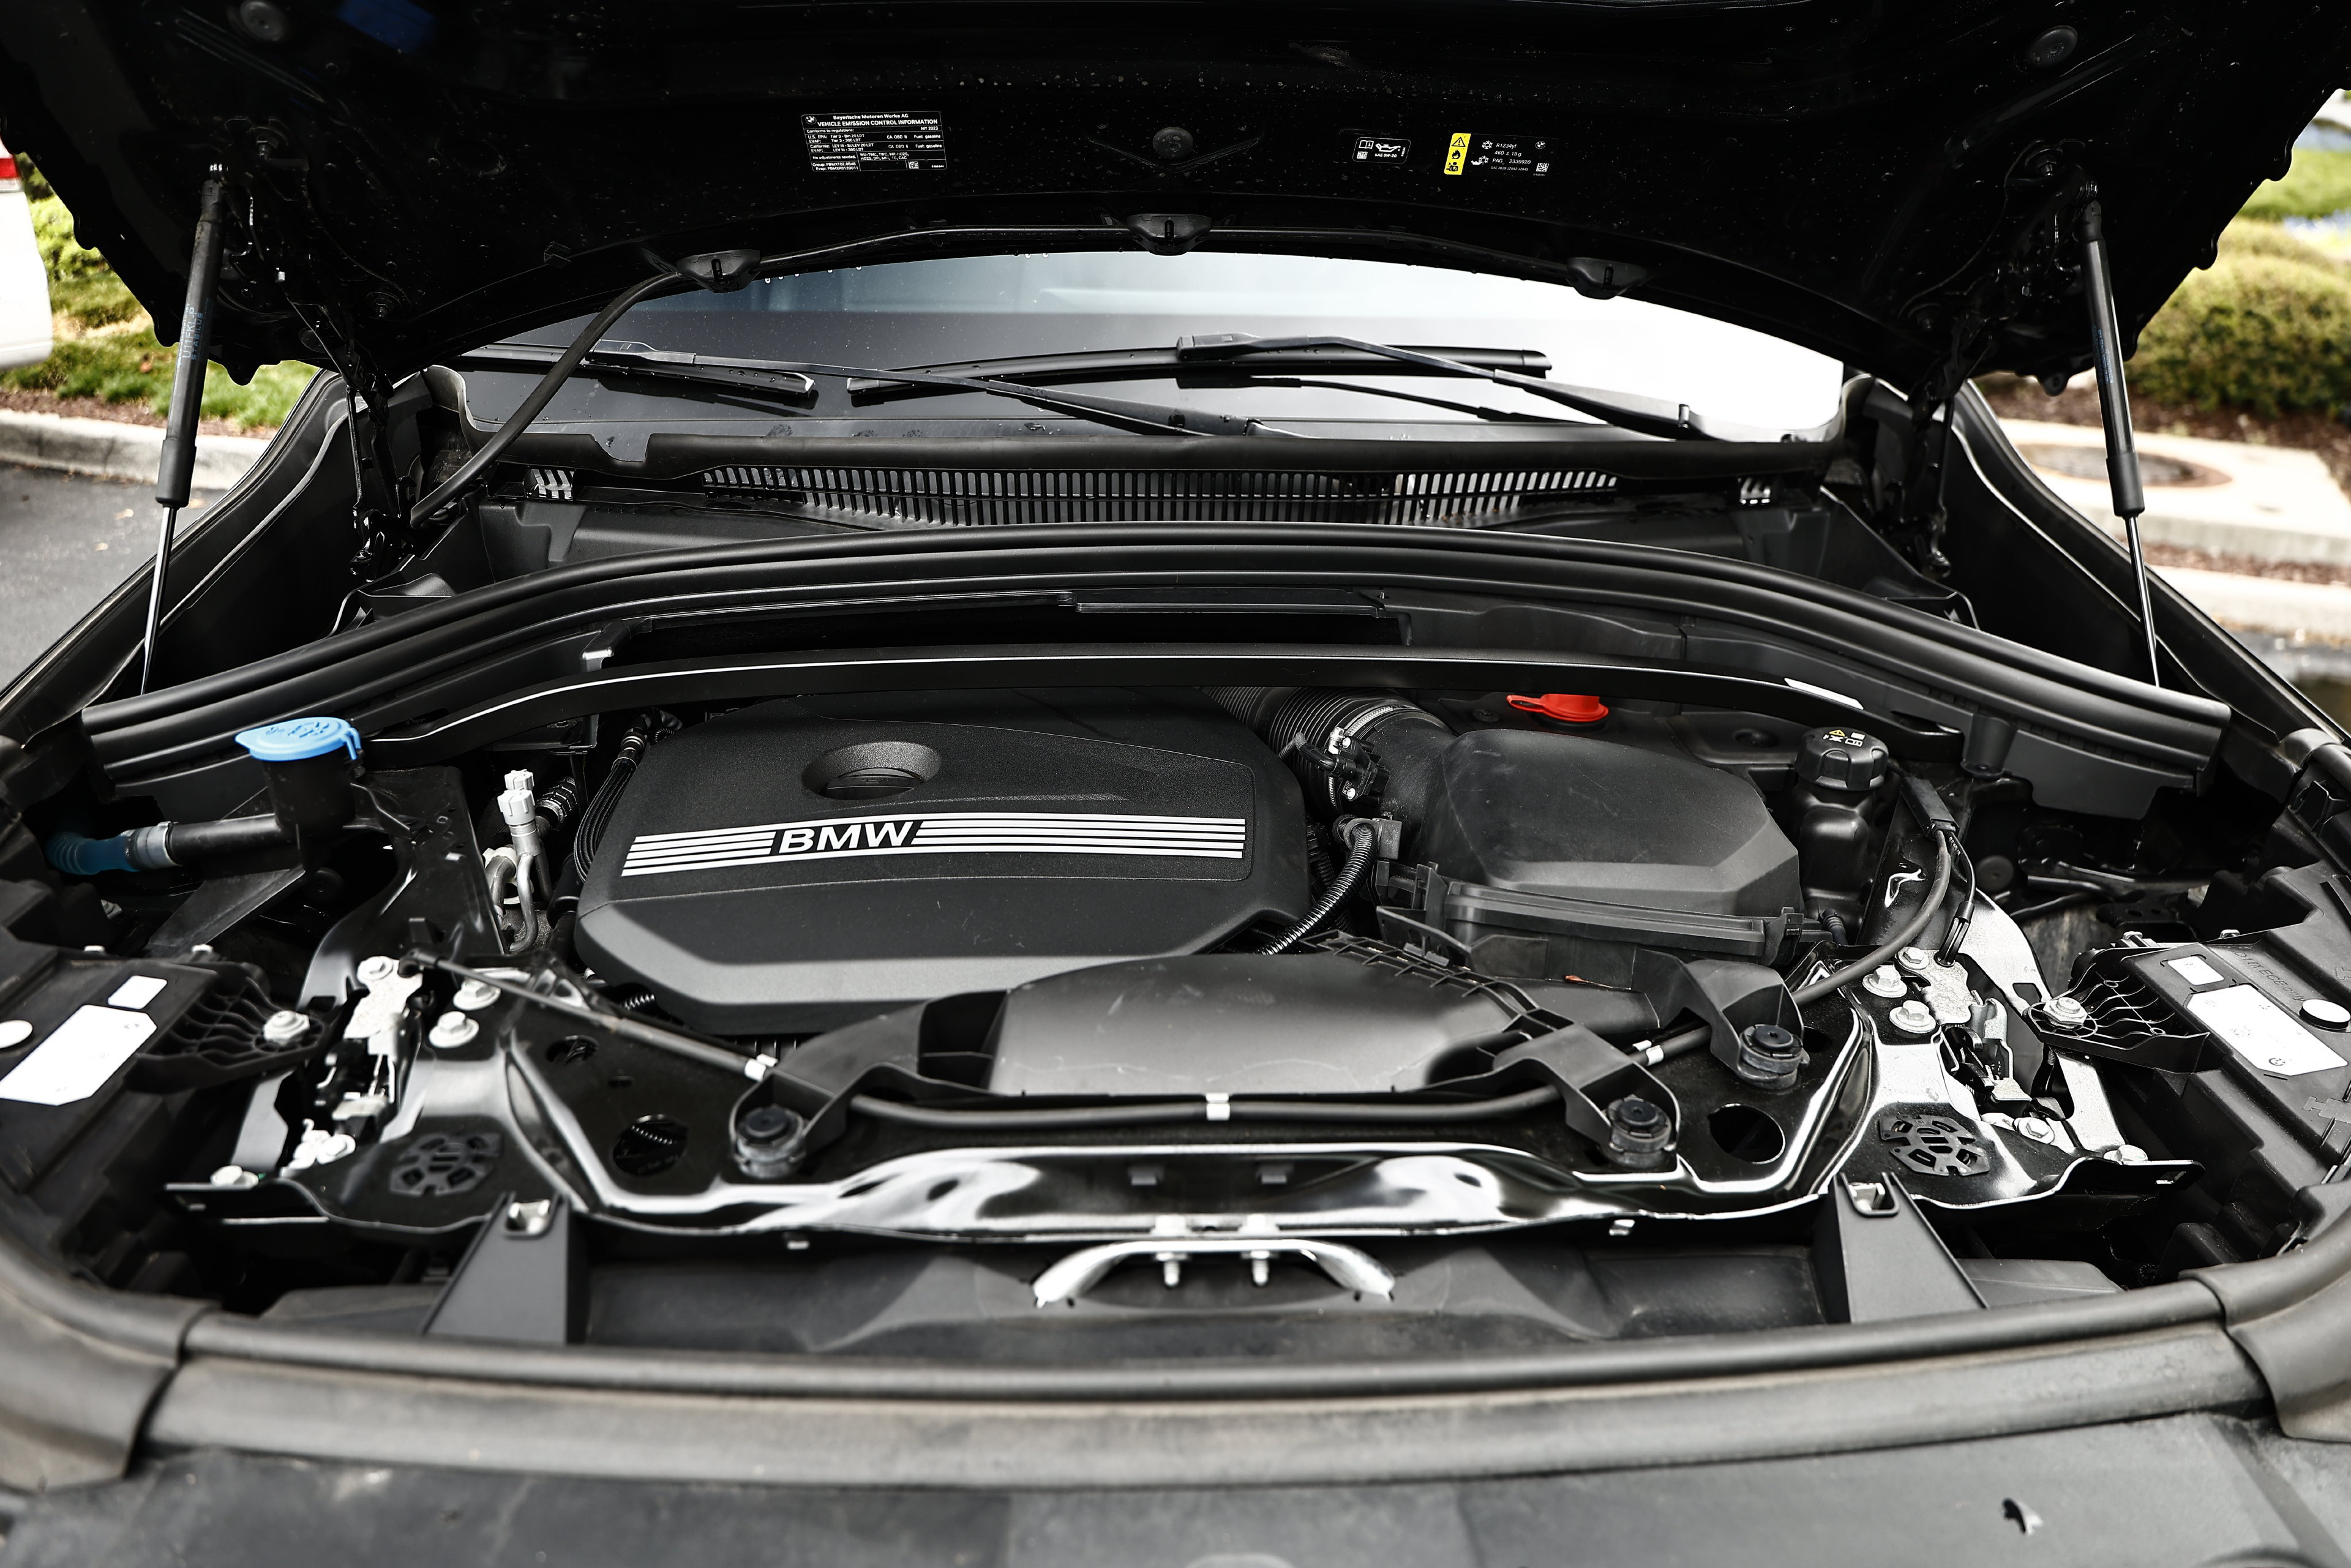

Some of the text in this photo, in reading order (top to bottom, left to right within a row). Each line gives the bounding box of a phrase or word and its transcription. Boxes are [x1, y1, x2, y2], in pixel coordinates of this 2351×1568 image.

[182, 307, 197, 358] U11FKL-P
[191, 312, 203, 361] STABILUS
[779, 821, 913, 854] BMW
[2259, 969, 2288, 986] ECE
